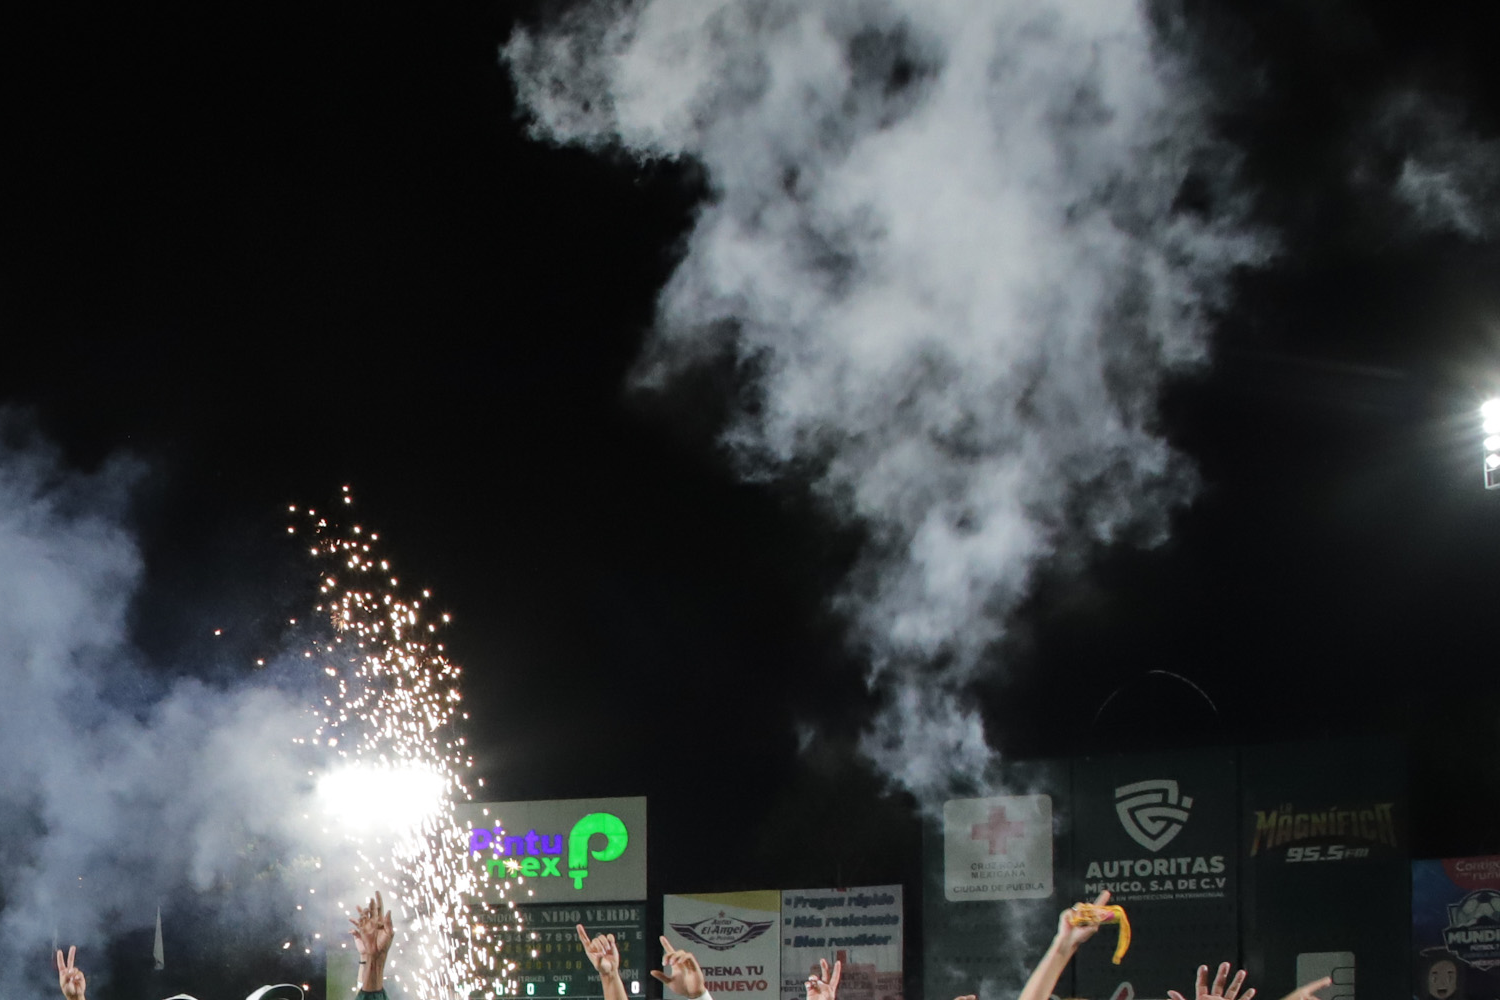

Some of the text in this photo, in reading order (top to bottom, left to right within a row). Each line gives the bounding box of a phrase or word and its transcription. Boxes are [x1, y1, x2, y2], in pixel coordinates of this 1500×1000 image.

[470, 826, 563, 856] Pintu
[1285, 845, 1345, 863] 95.5
[486, 856, 562, 878] mex
[1085, 856, 1226, 878] AUTORITAS
[1085, 877, 1226, 894] MÉXICO, S.A DE C.V
[541, 908, 640, 922] NIDO VERDE
[553, 975, 572, 983] OUTS
[746, 966, 763, 976] TU
[526, 982, 535, 996] 0
[557, 982, 567, 995] 2
[631, 980, 640, 994] 0
